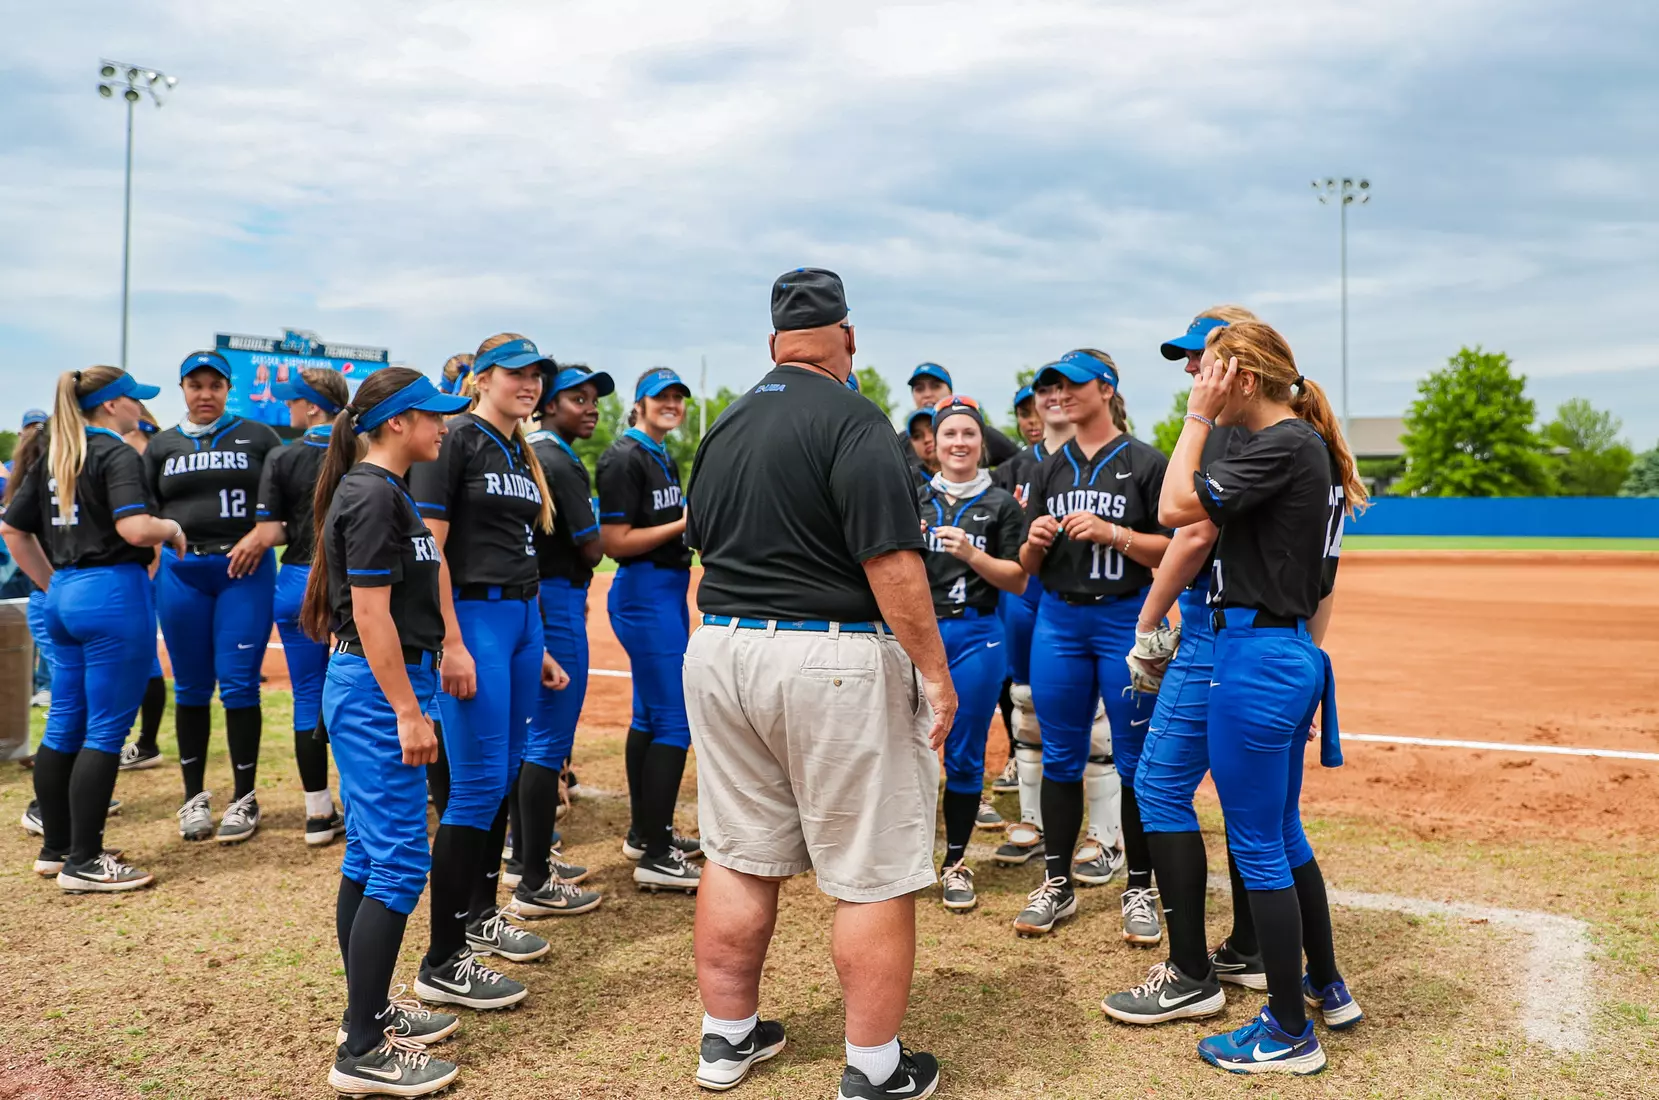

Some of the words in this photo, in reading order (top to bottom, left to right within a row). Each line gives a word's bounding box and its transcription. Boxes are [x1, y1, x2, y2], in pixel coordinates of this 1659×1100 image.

[163, 451, 249, 476] RAIDERS
[219, 488, 247, 518] 12
[1046, 489, 1127, 519] RAIDERS
[1089, 543, 1124, 580] 10
[948, 576, 966, 604] 4
